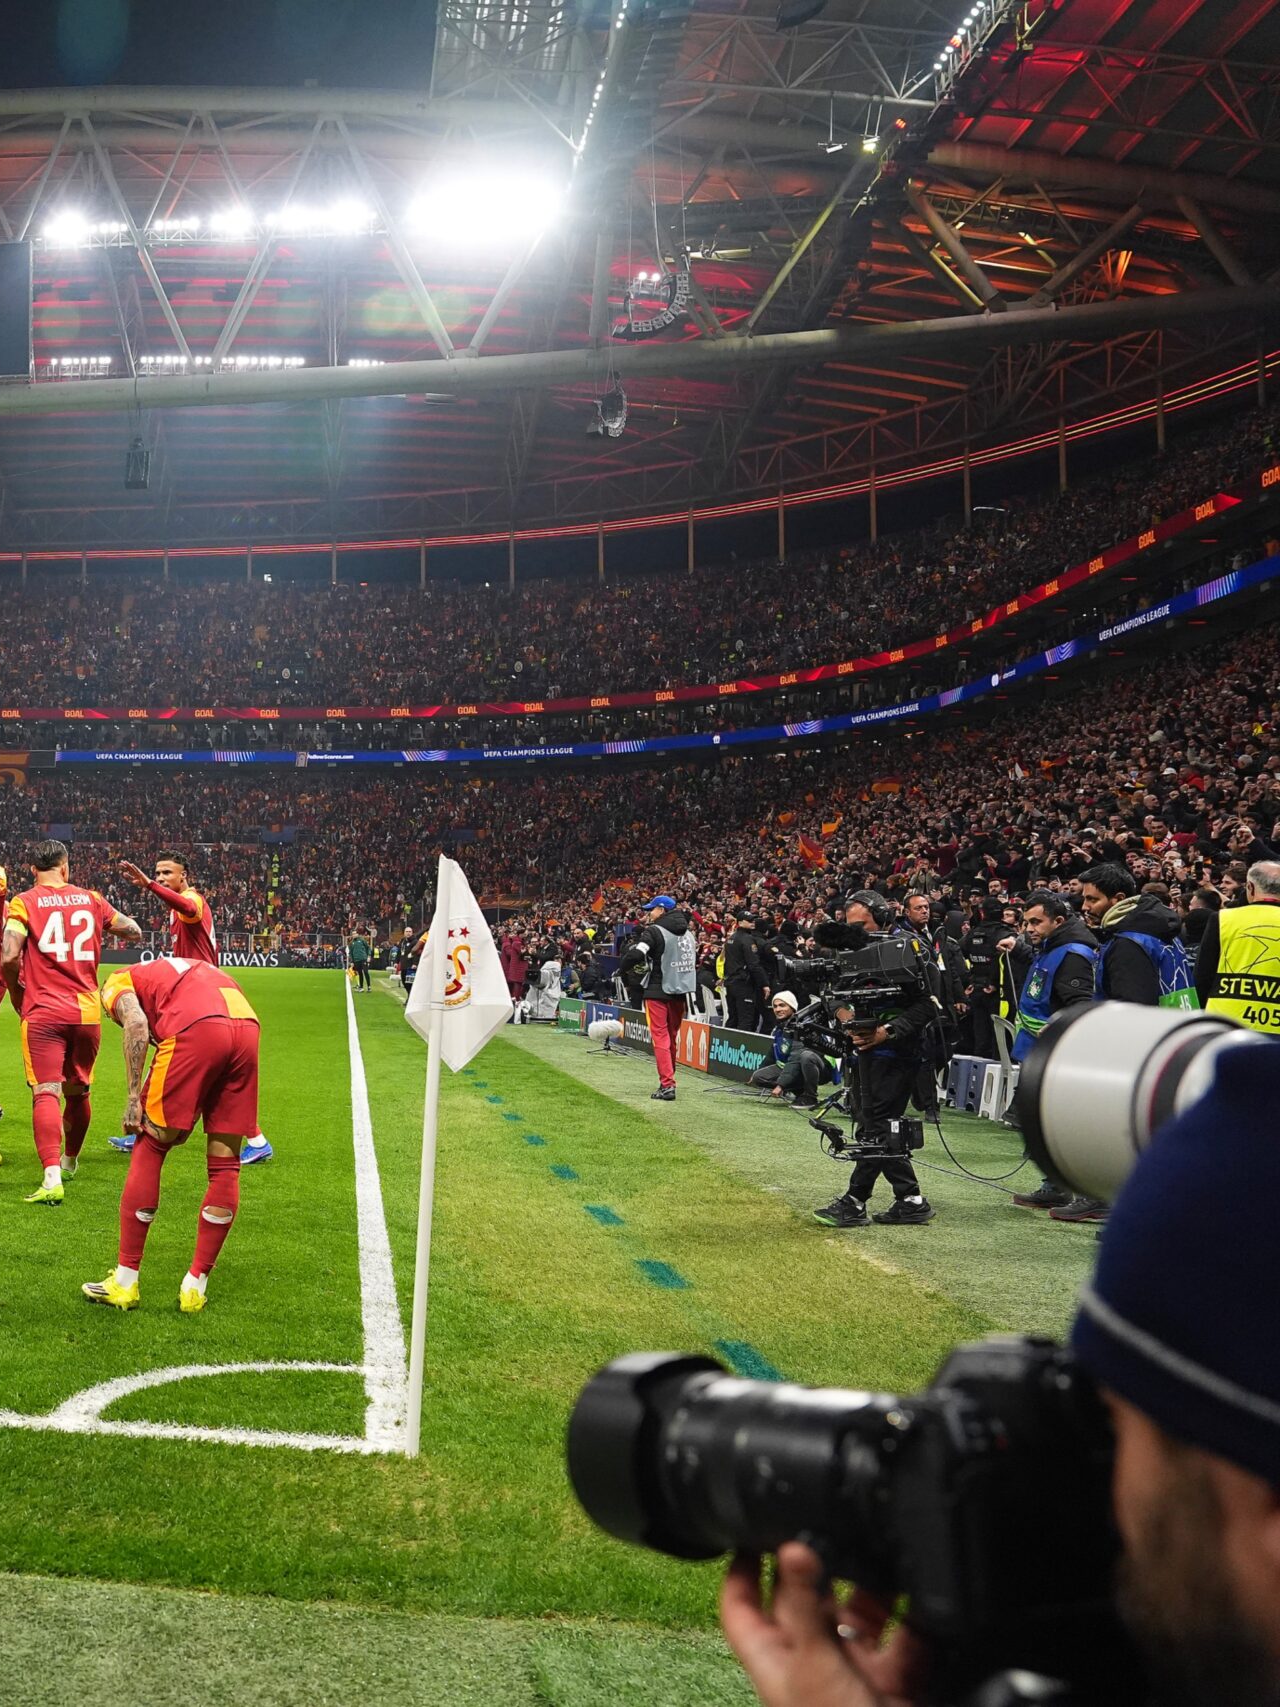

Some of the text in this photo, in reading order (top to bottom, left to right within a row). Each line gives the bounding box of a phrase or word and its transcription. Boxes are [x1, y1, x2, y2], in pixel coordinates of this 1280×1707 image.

[1195, 500, 1214, 520] GOAL
[1138, 530, 1155, 548] GOAL
[1089, 557, 1104, 573] GOAL
[1045, 580, 1058, 595] GOAL
[1006, 601, 1018, 614] GOAL
[1099, 604, 1170, 641] UEFA CHAMPIONS LEAGUE
[890, 649, 904, 661] GOAL
[838, 662, 853, 673] GOAL
[719, 684, 737, 693] GOAL
[655, 692, 674, 700] GOAL
[524, 703, 544, 711] GOAL
[591, 698, 610, 706] GOAL
[64, 710, 84, 718] GOAL
[194, 709, 214, 717] GOAL
[260, 709, 279, 718] GOAL
[390, 708, 410, 716] GOAL
[457, 706, 477, 714] GOAL
[851, 702, 920, 724] UEFA CHAMPIONS LEAGUE
[484, 747, 574, 758] UEFA CHAMPIONS LEAGUE
[37, 893, 92, 909] ABDÜLKERİM
[37, 909, 95, 963] 42
[218, 952, 279, 967] IRWAYS
